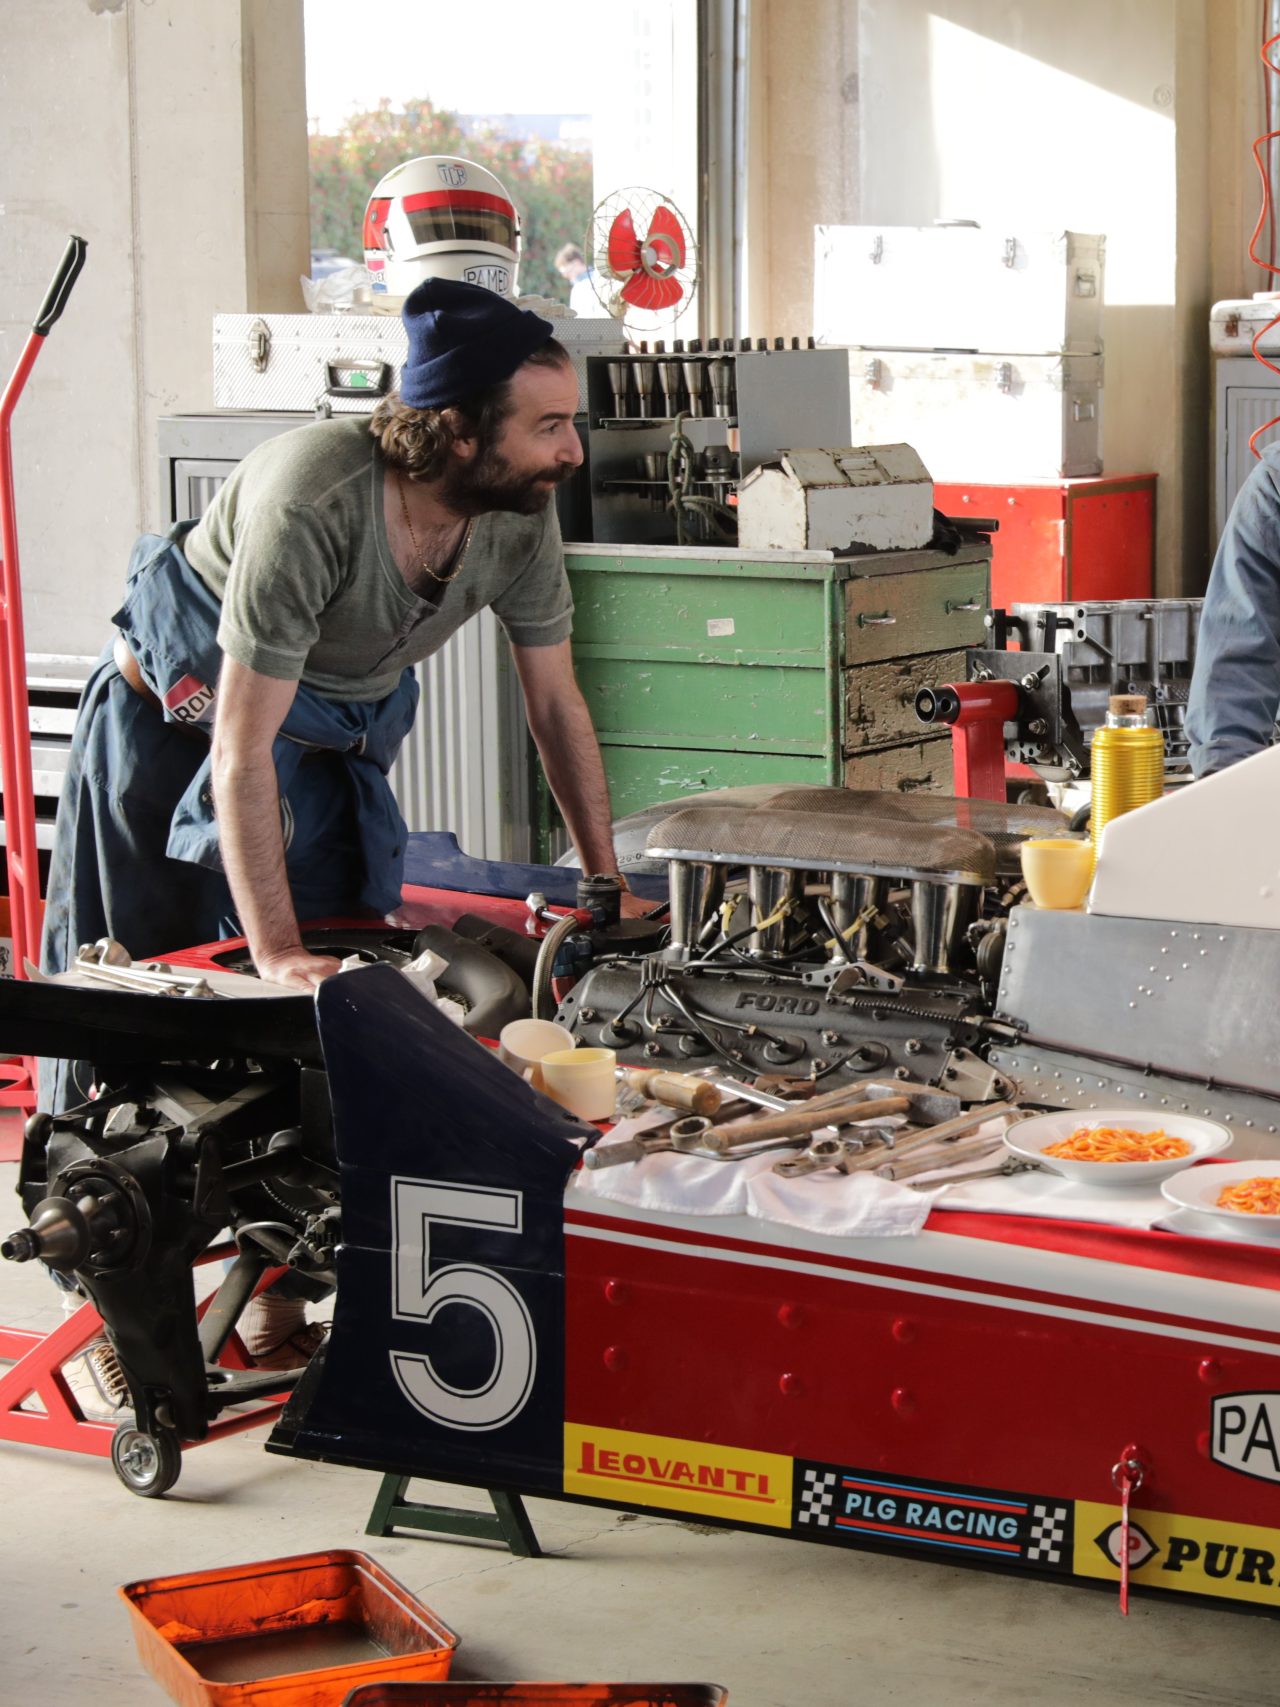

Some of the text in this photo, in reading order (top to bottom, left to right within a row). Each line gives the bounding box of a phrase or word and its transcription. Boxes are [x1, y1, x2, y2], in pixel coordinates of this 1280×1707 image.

[440, 166, 467, 186] TCR
[467, 268, 509, 293] PAMED
[173, 685, 215, 722] ROV
[735, 992, 820, 1016] FORD
[389, 1175, 537, 1432] 5
[577, 1441, 769, 1495] LEOVANTI
[845, 1493, 1018, 1539] PLG RACING
